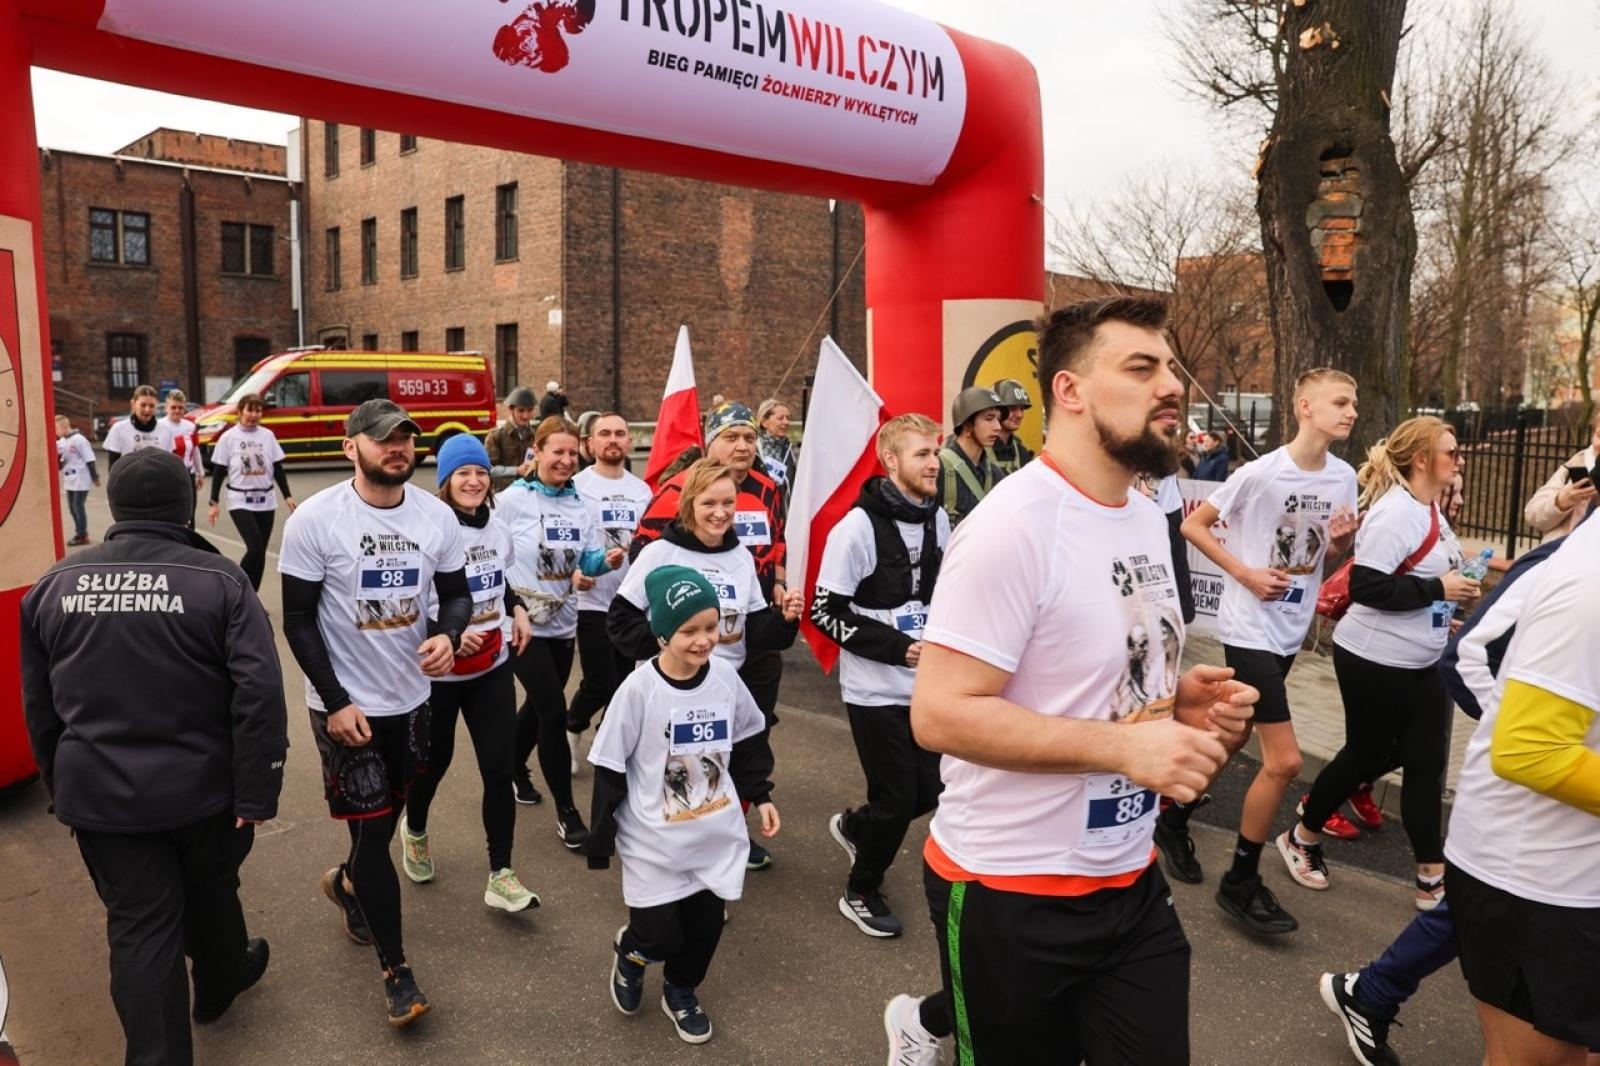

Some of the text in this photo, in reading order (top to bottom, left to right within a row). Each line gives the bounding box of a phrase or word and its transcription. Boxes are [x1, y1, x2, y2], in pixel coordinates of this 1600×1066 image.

[647, 49, 919, 126] BIEG PAMIĘCI ŻOŁNIERZY WYKLĘTYCH
[610, 510, 631, 521] 128
[558, 528, 574, 541] 95
[745, 523, 755, 537] 2
[380, 540, 421, 552] WILCZYM
[76, 570, 170, 592] SŁUŻBA
[381, 570, 405, 587] 98
[480, 573, 496, 590] 97
[61, 593, 185, 616] WIĘZIENNA
[691, 722, 714, 742] 96
[1115, 792, 1146, 823] 88
